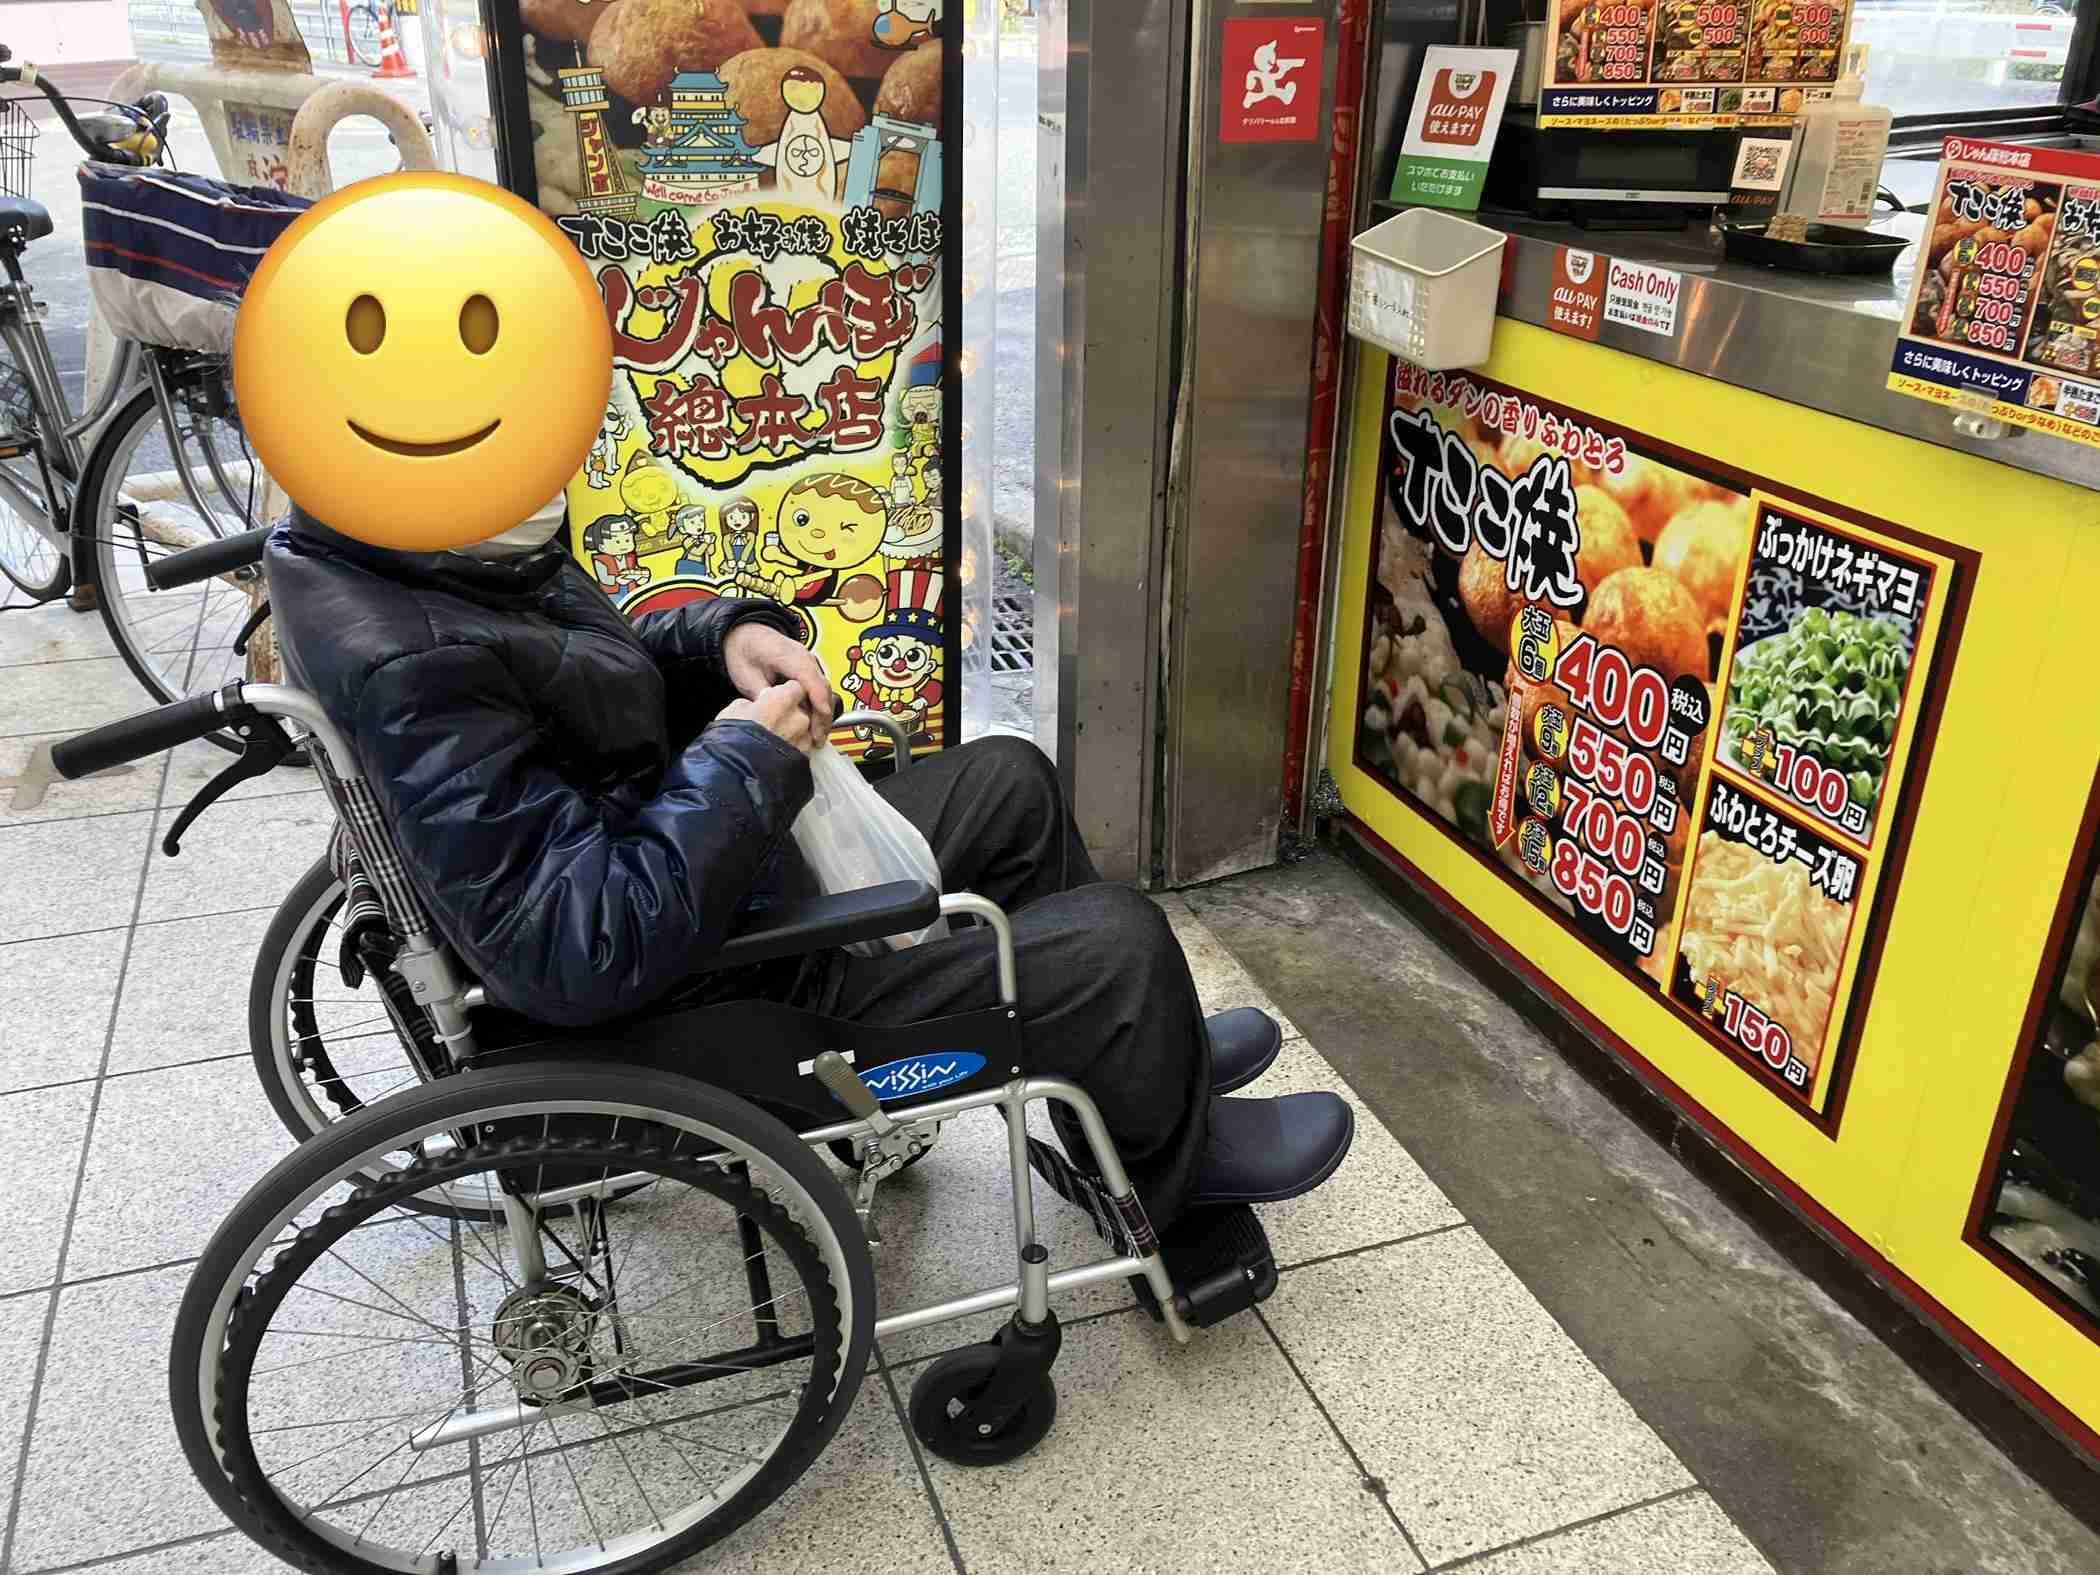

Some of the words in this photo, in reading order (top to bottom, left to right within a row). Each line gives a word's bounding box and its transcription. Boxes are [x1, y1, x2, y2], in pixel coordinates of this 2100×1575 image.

[1457, 105, 1483, 120] PAY
[1948, 180, 2027, 230] たこ焼
[557, 210, 697, 262] たこ焼
[713, 208, 831, 261] お好み焼
[1576, 292, 1599, 311] PAY
[1611, 265, 1644, 292] Cash
[1646, 273, 1678, 305] Only
[600, 263, 934, 369] じゃんぼ
[1903, 350, 2024, 391] さらに美味しくトッピング
[1390, 409, 1586, 608] たこ焼
[1670, 687, 1704, 724] 税込
[1709, 783, 1858, 901] ふわとろチーズ卵
